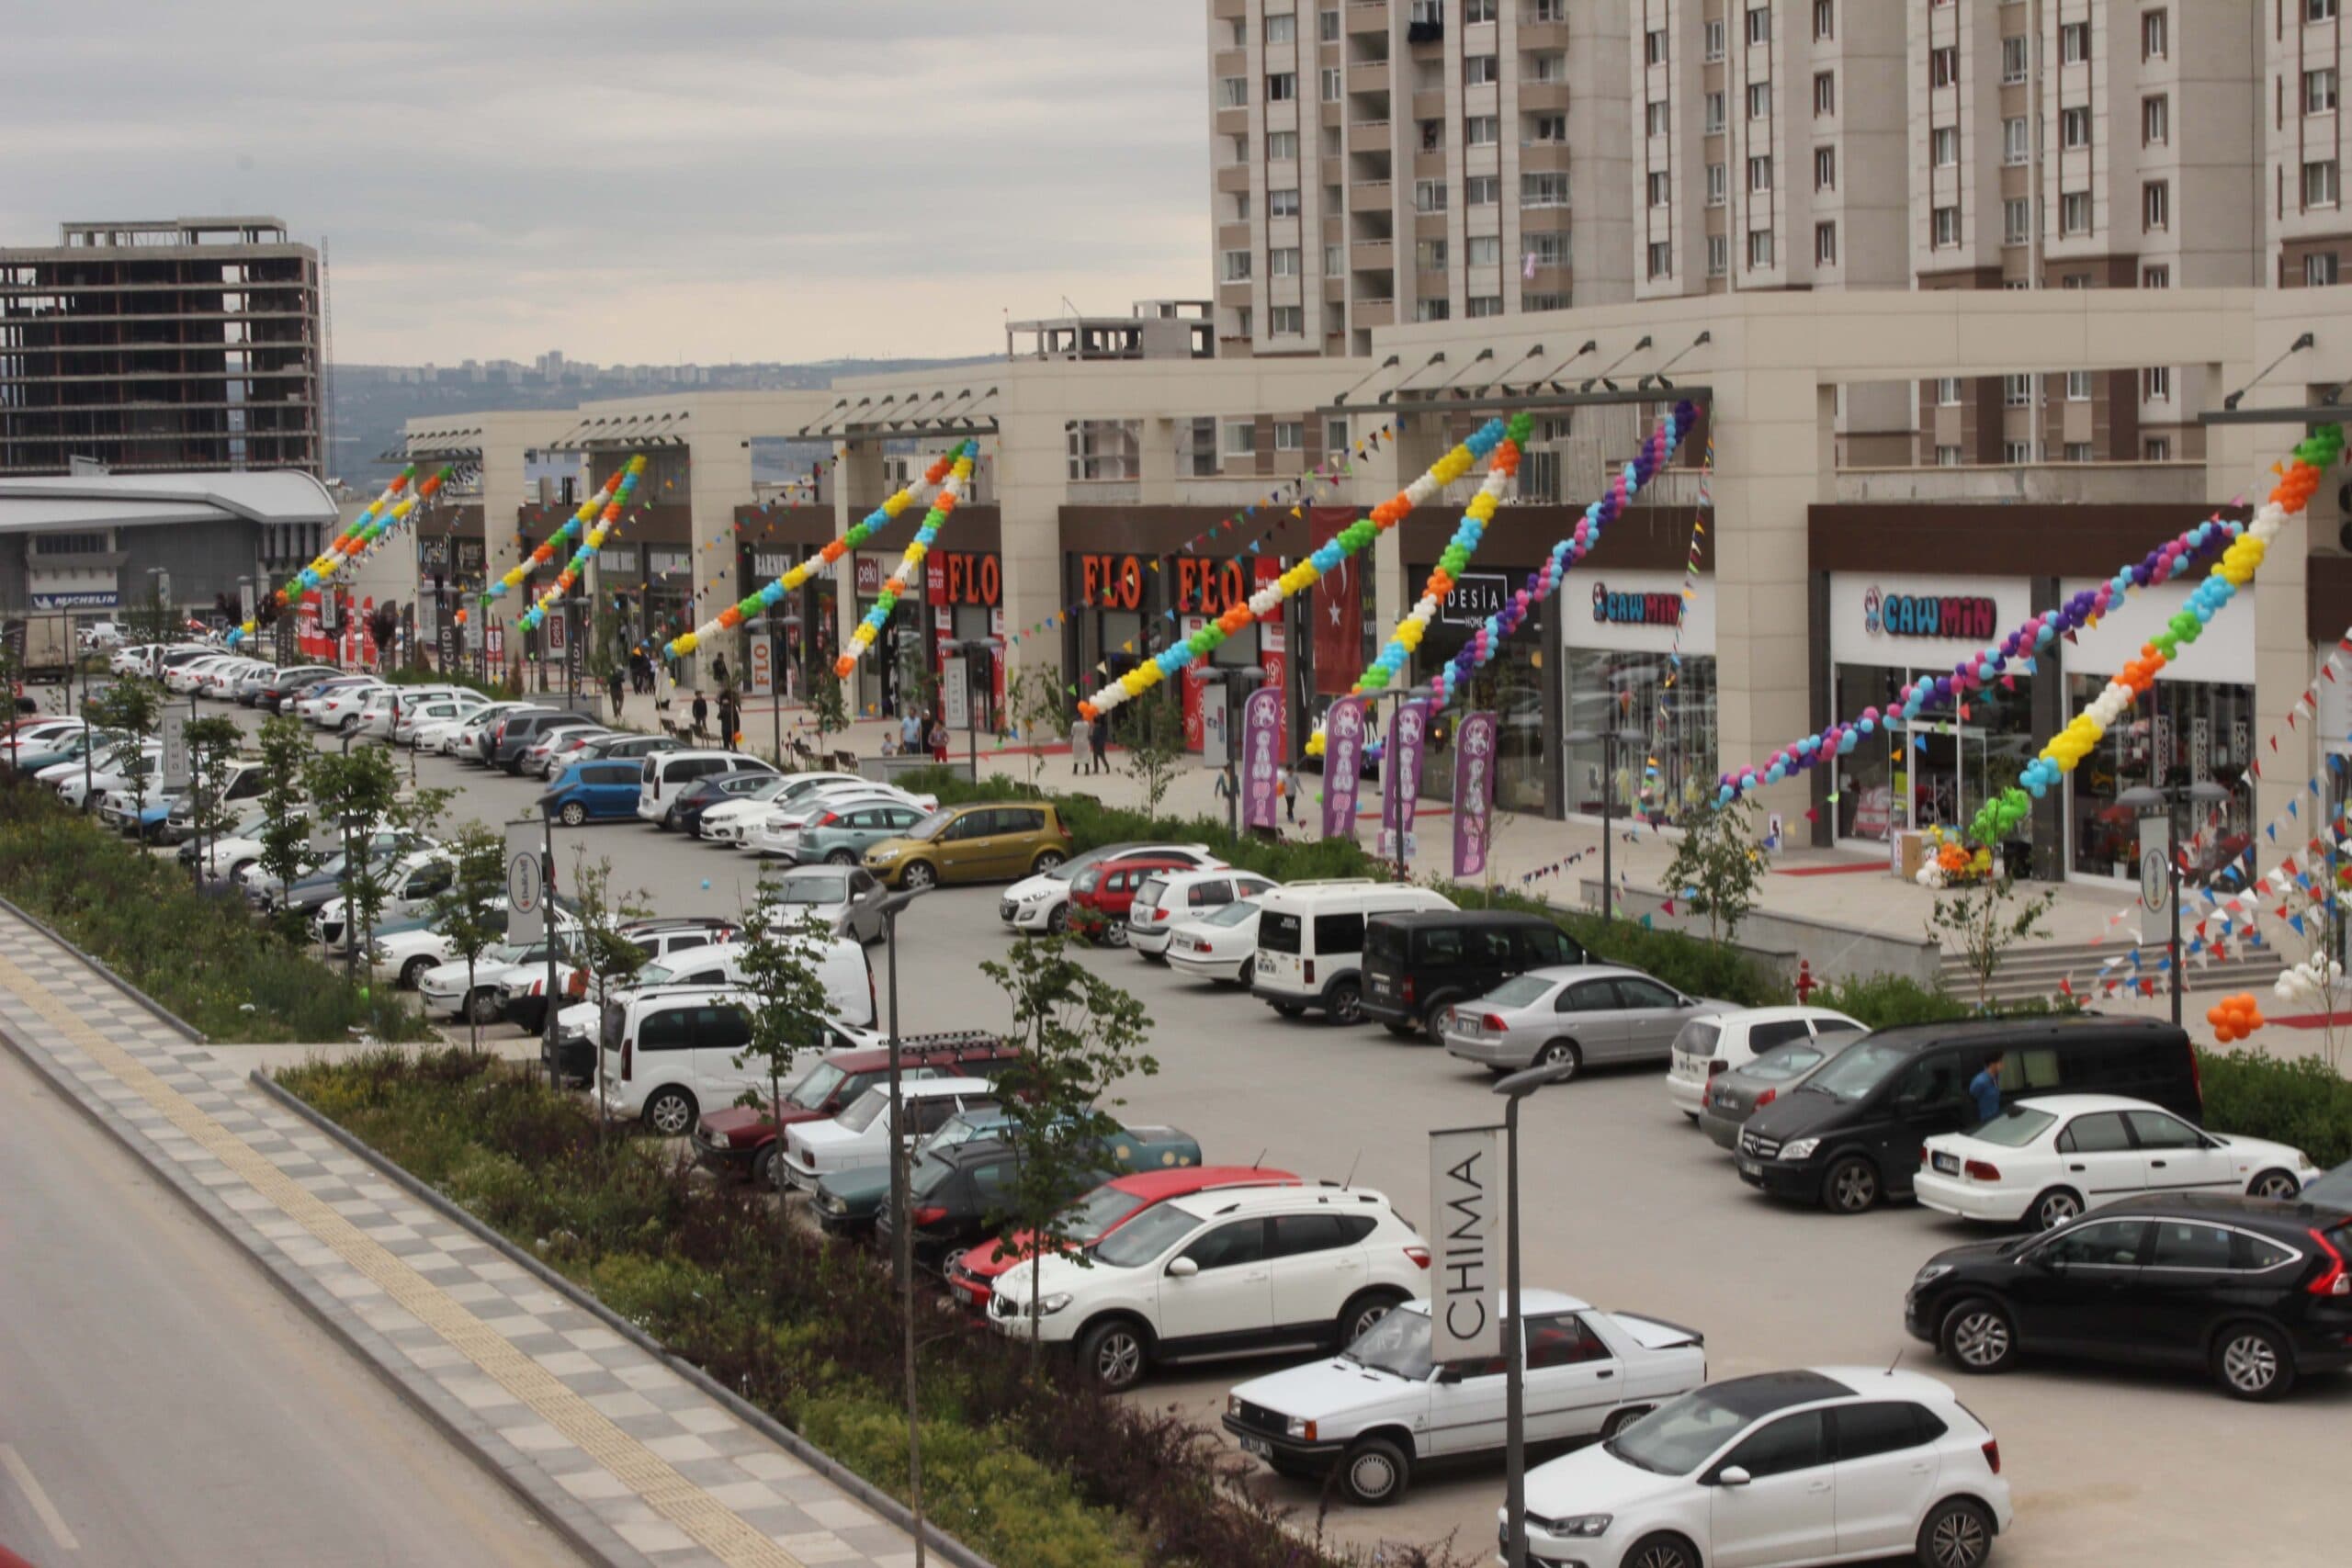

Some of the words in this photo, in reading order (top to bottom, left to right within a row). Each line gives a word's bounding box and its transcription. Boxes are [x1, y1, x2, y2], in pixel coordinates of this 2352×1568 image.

[858, 559, 877, 588] peki
[948, 554, 1000, 606] FLO
[1082, 555, 1141, 610] FLO
[1178, 558, 1243, 615] FLO
[55, 594, 117, 605] MICHELIN
[1464, 616, 1484, 627] HOME
[754, 644, 769, 686] FLO
[1446, 1151, 1486, 1340] CHIMA
